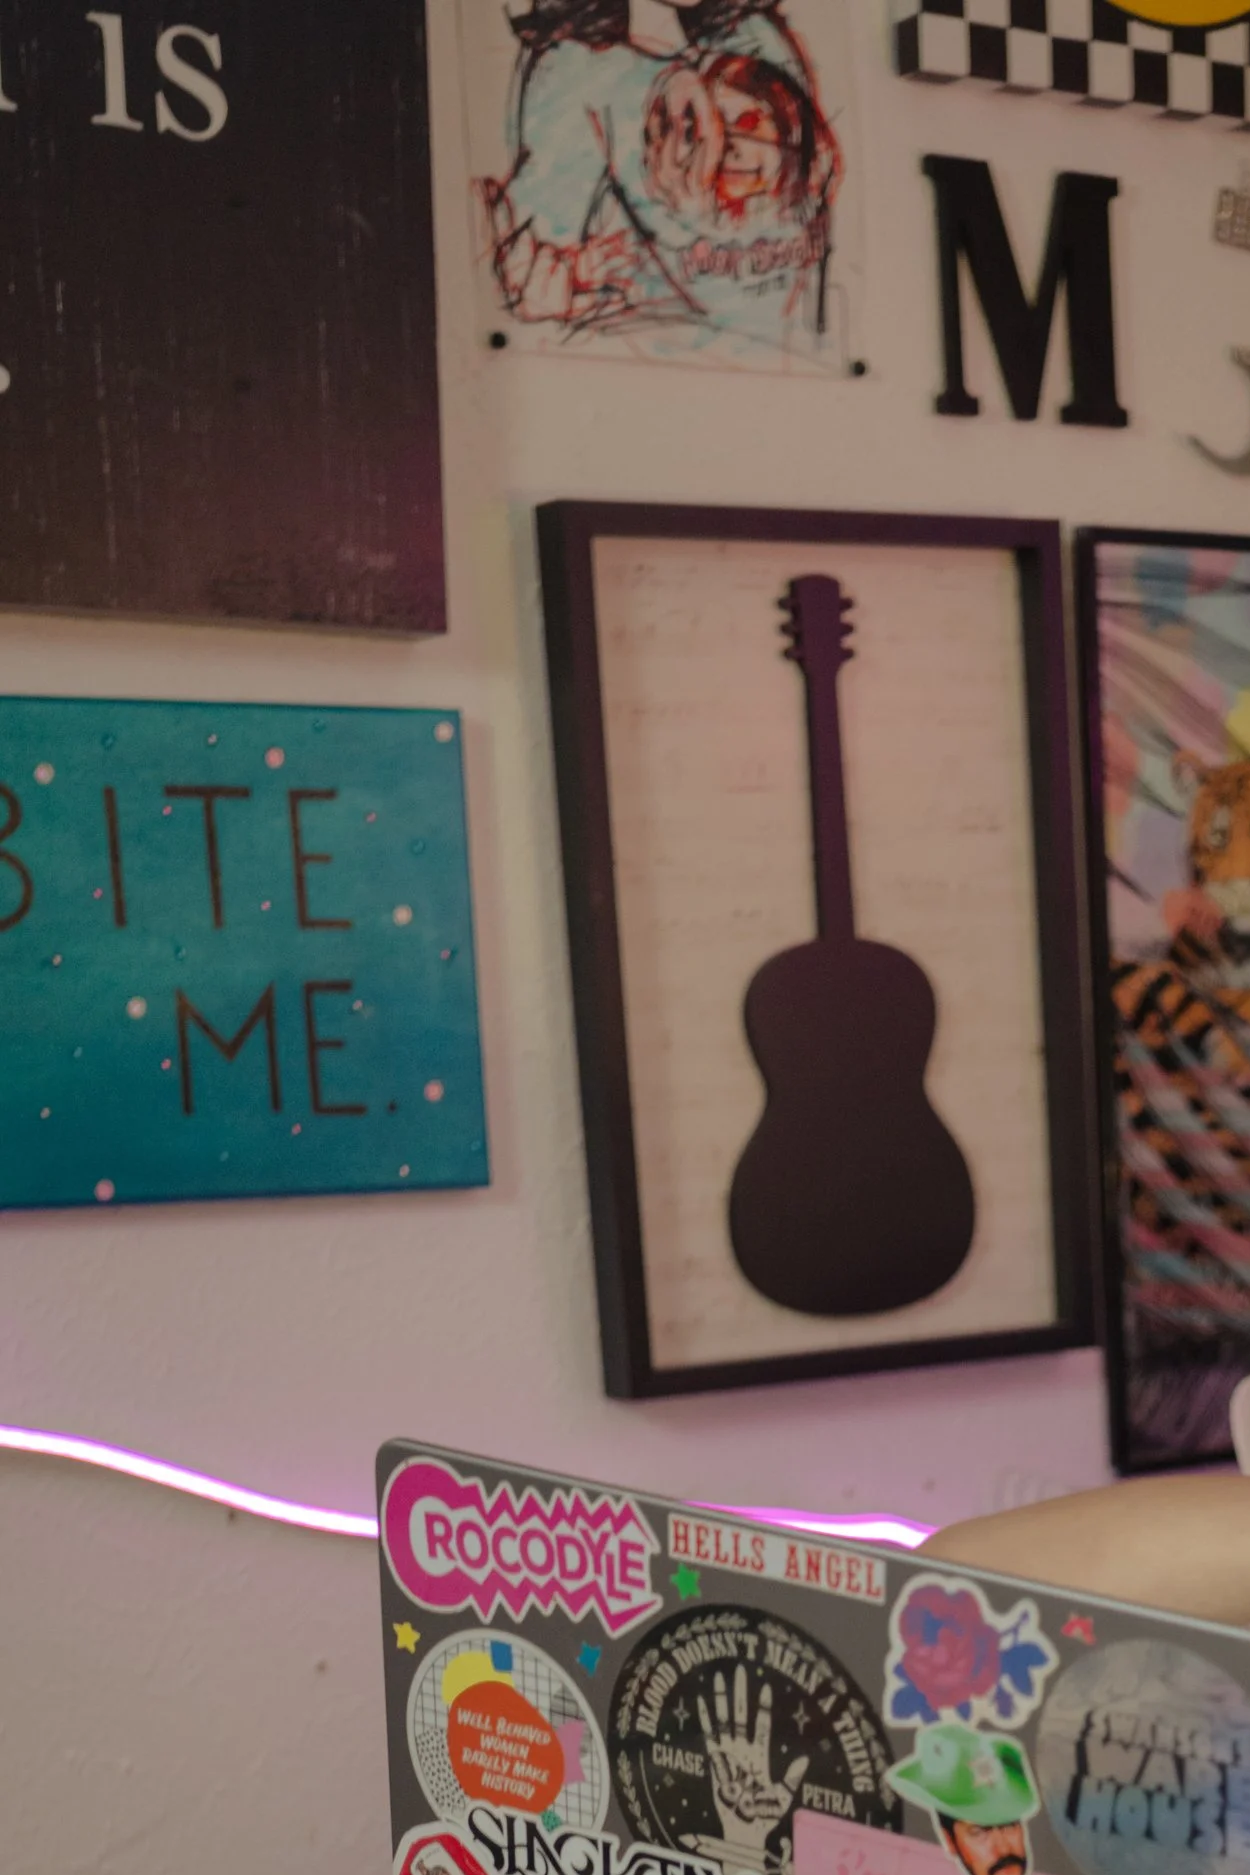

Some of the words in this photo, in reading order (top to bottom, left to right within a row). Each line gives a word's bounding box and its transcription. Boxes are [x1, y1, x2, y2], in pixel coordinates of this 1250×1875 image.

[86, 11, 229, 142] is
[922, 153, 1129, 428] M
[672, 1518, 766, 1572] HELLS
[784, 1544, 883, 1599] ANGEL
[636, 1662, 678, 1738] BLOOD
[818, 1693, 838, 1714] A
[480, 1733, 531, 1760] WOMEN
[652, 1743, 706, 1777] CHASE
[802, 1783, 856, 1818] PETRA
[480, 1770, 536, 1801] HISTORY
